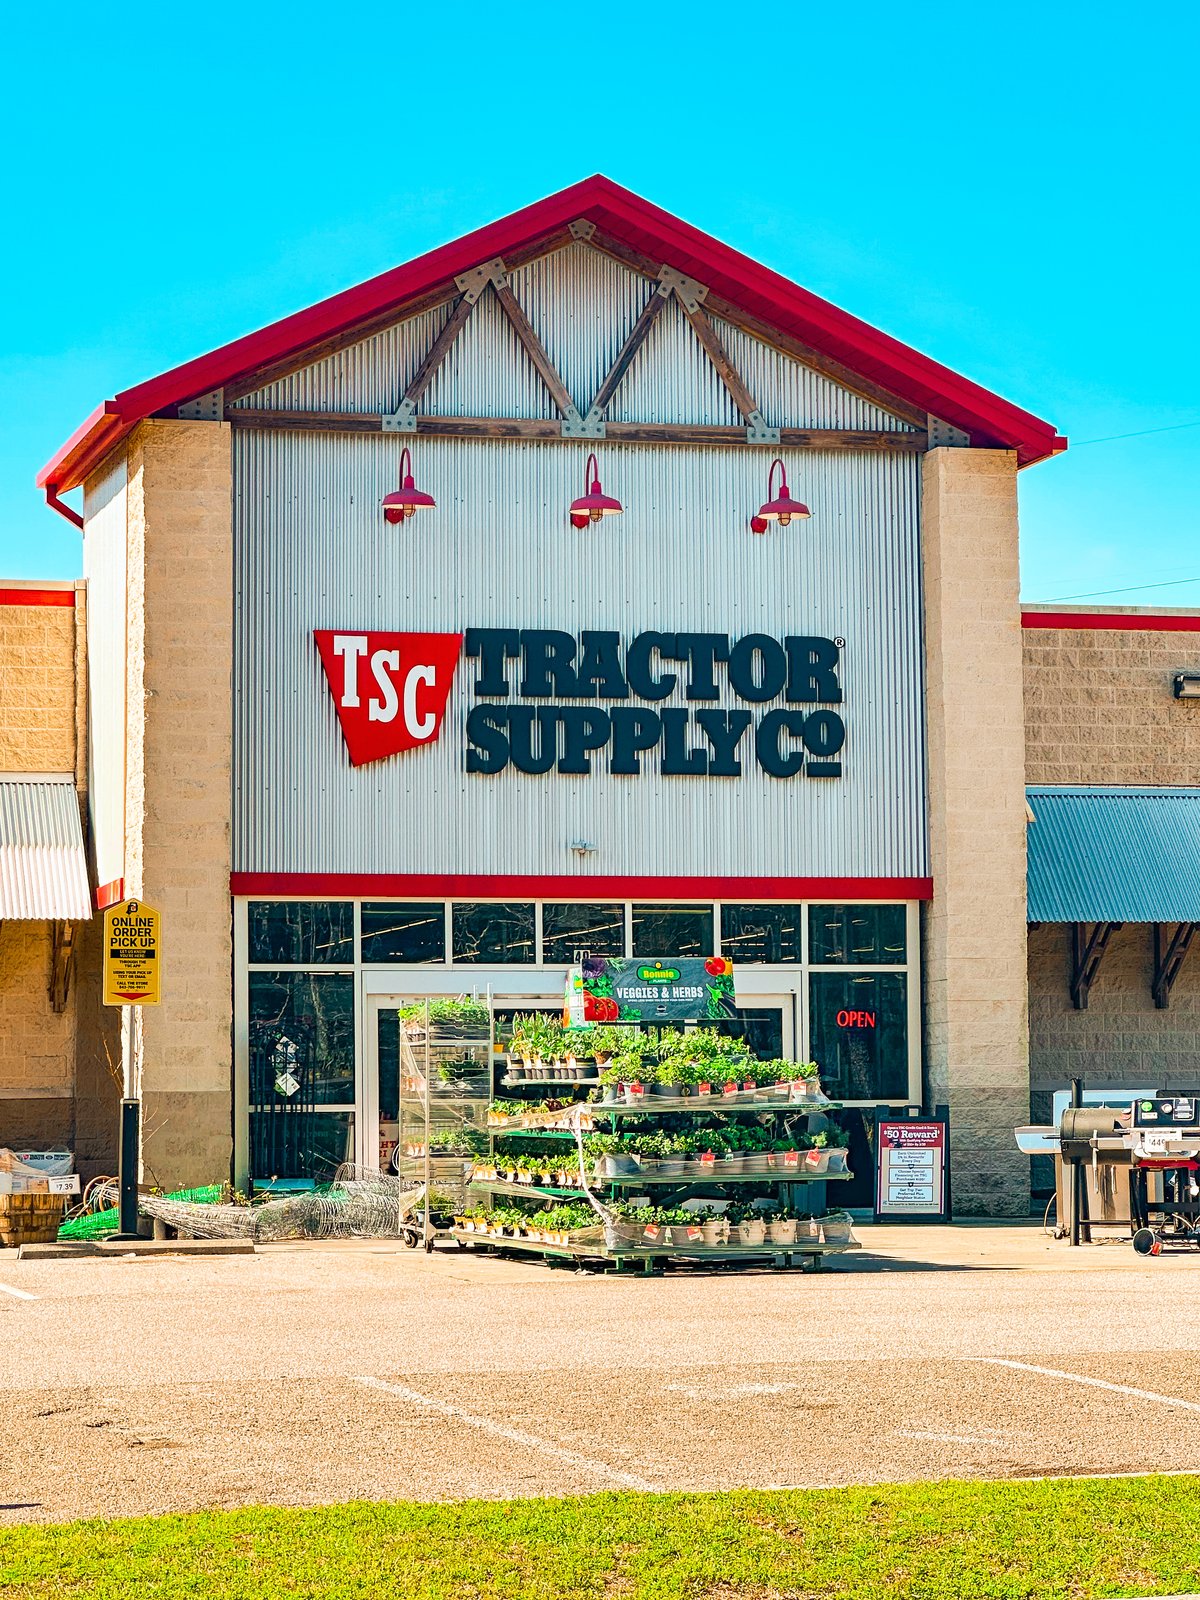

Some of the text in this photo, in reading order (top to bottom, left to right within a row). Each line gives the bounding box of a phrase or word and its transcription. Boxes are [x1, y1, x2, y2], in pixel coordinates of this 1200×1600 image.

[465, 627, 843, 703] TRACTOR
[333, 635, 436, 740] TSC
[465, 703, 752, 775] SUPPLY
[111, 917, 154, 927] ONLINE
[113, 927, 152, 937] ORDER
[110, 937, 156, 947] PICK UP
[643, 970, 675, 979] Bonnie
[616, 986, 704, 999] VEGGIES & HERBS
[836, 1010, 876, 1028] OPEN
